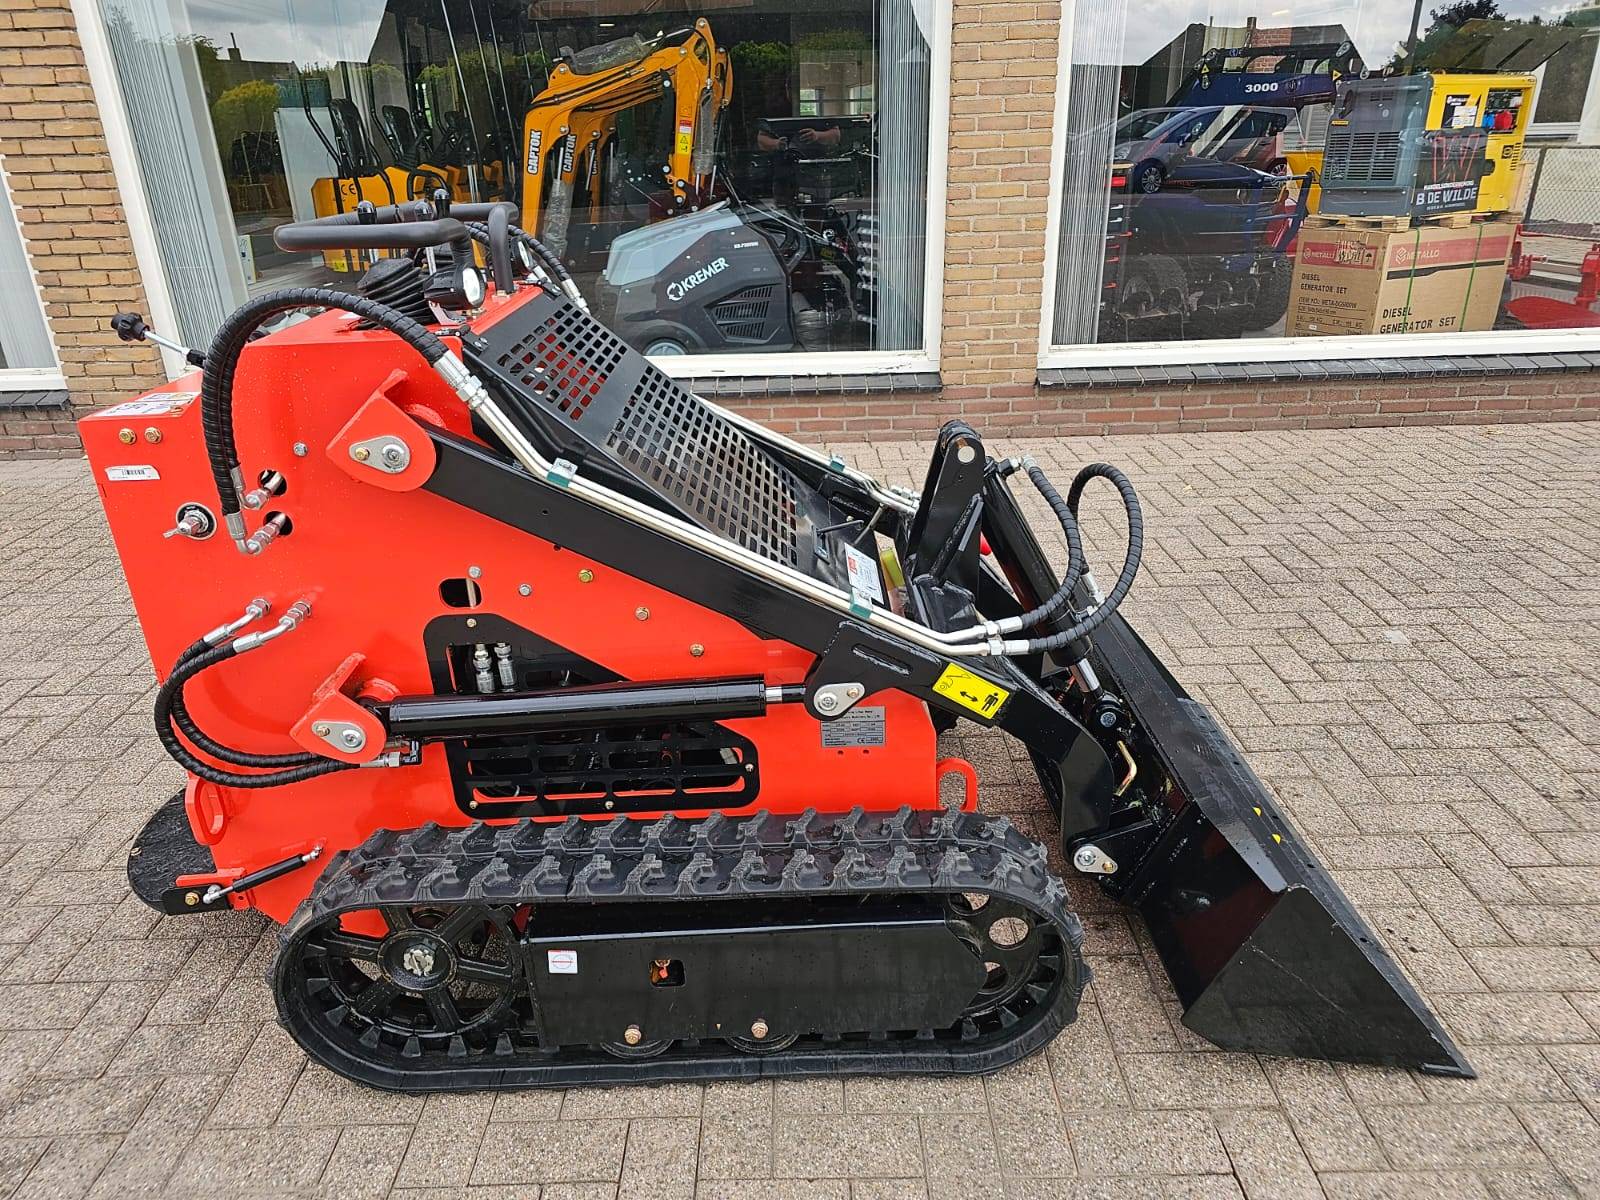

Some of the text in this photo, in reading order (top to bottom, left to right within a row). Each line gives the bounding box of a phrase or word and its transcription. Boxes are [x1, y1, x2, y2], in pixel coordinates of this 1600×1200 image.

[1244, 82, 1279, 93] 3000
[527, 130, 542, 174] CAPTOK
[563, 134, 577, 172] CAPTOK
[1428, 191, 1442, 204] DE
[1443, 187, 1478, 202] WILDE
[681, 257, 730, 291] KREMER
[1301, 273, 1320, 281] DIESEL
[1300, 283, 1333, 293] GENERATOR
[1382, 307, 1412, 318] DIESEL
[1380, 316, 1457, 334] GENERATOR SET
